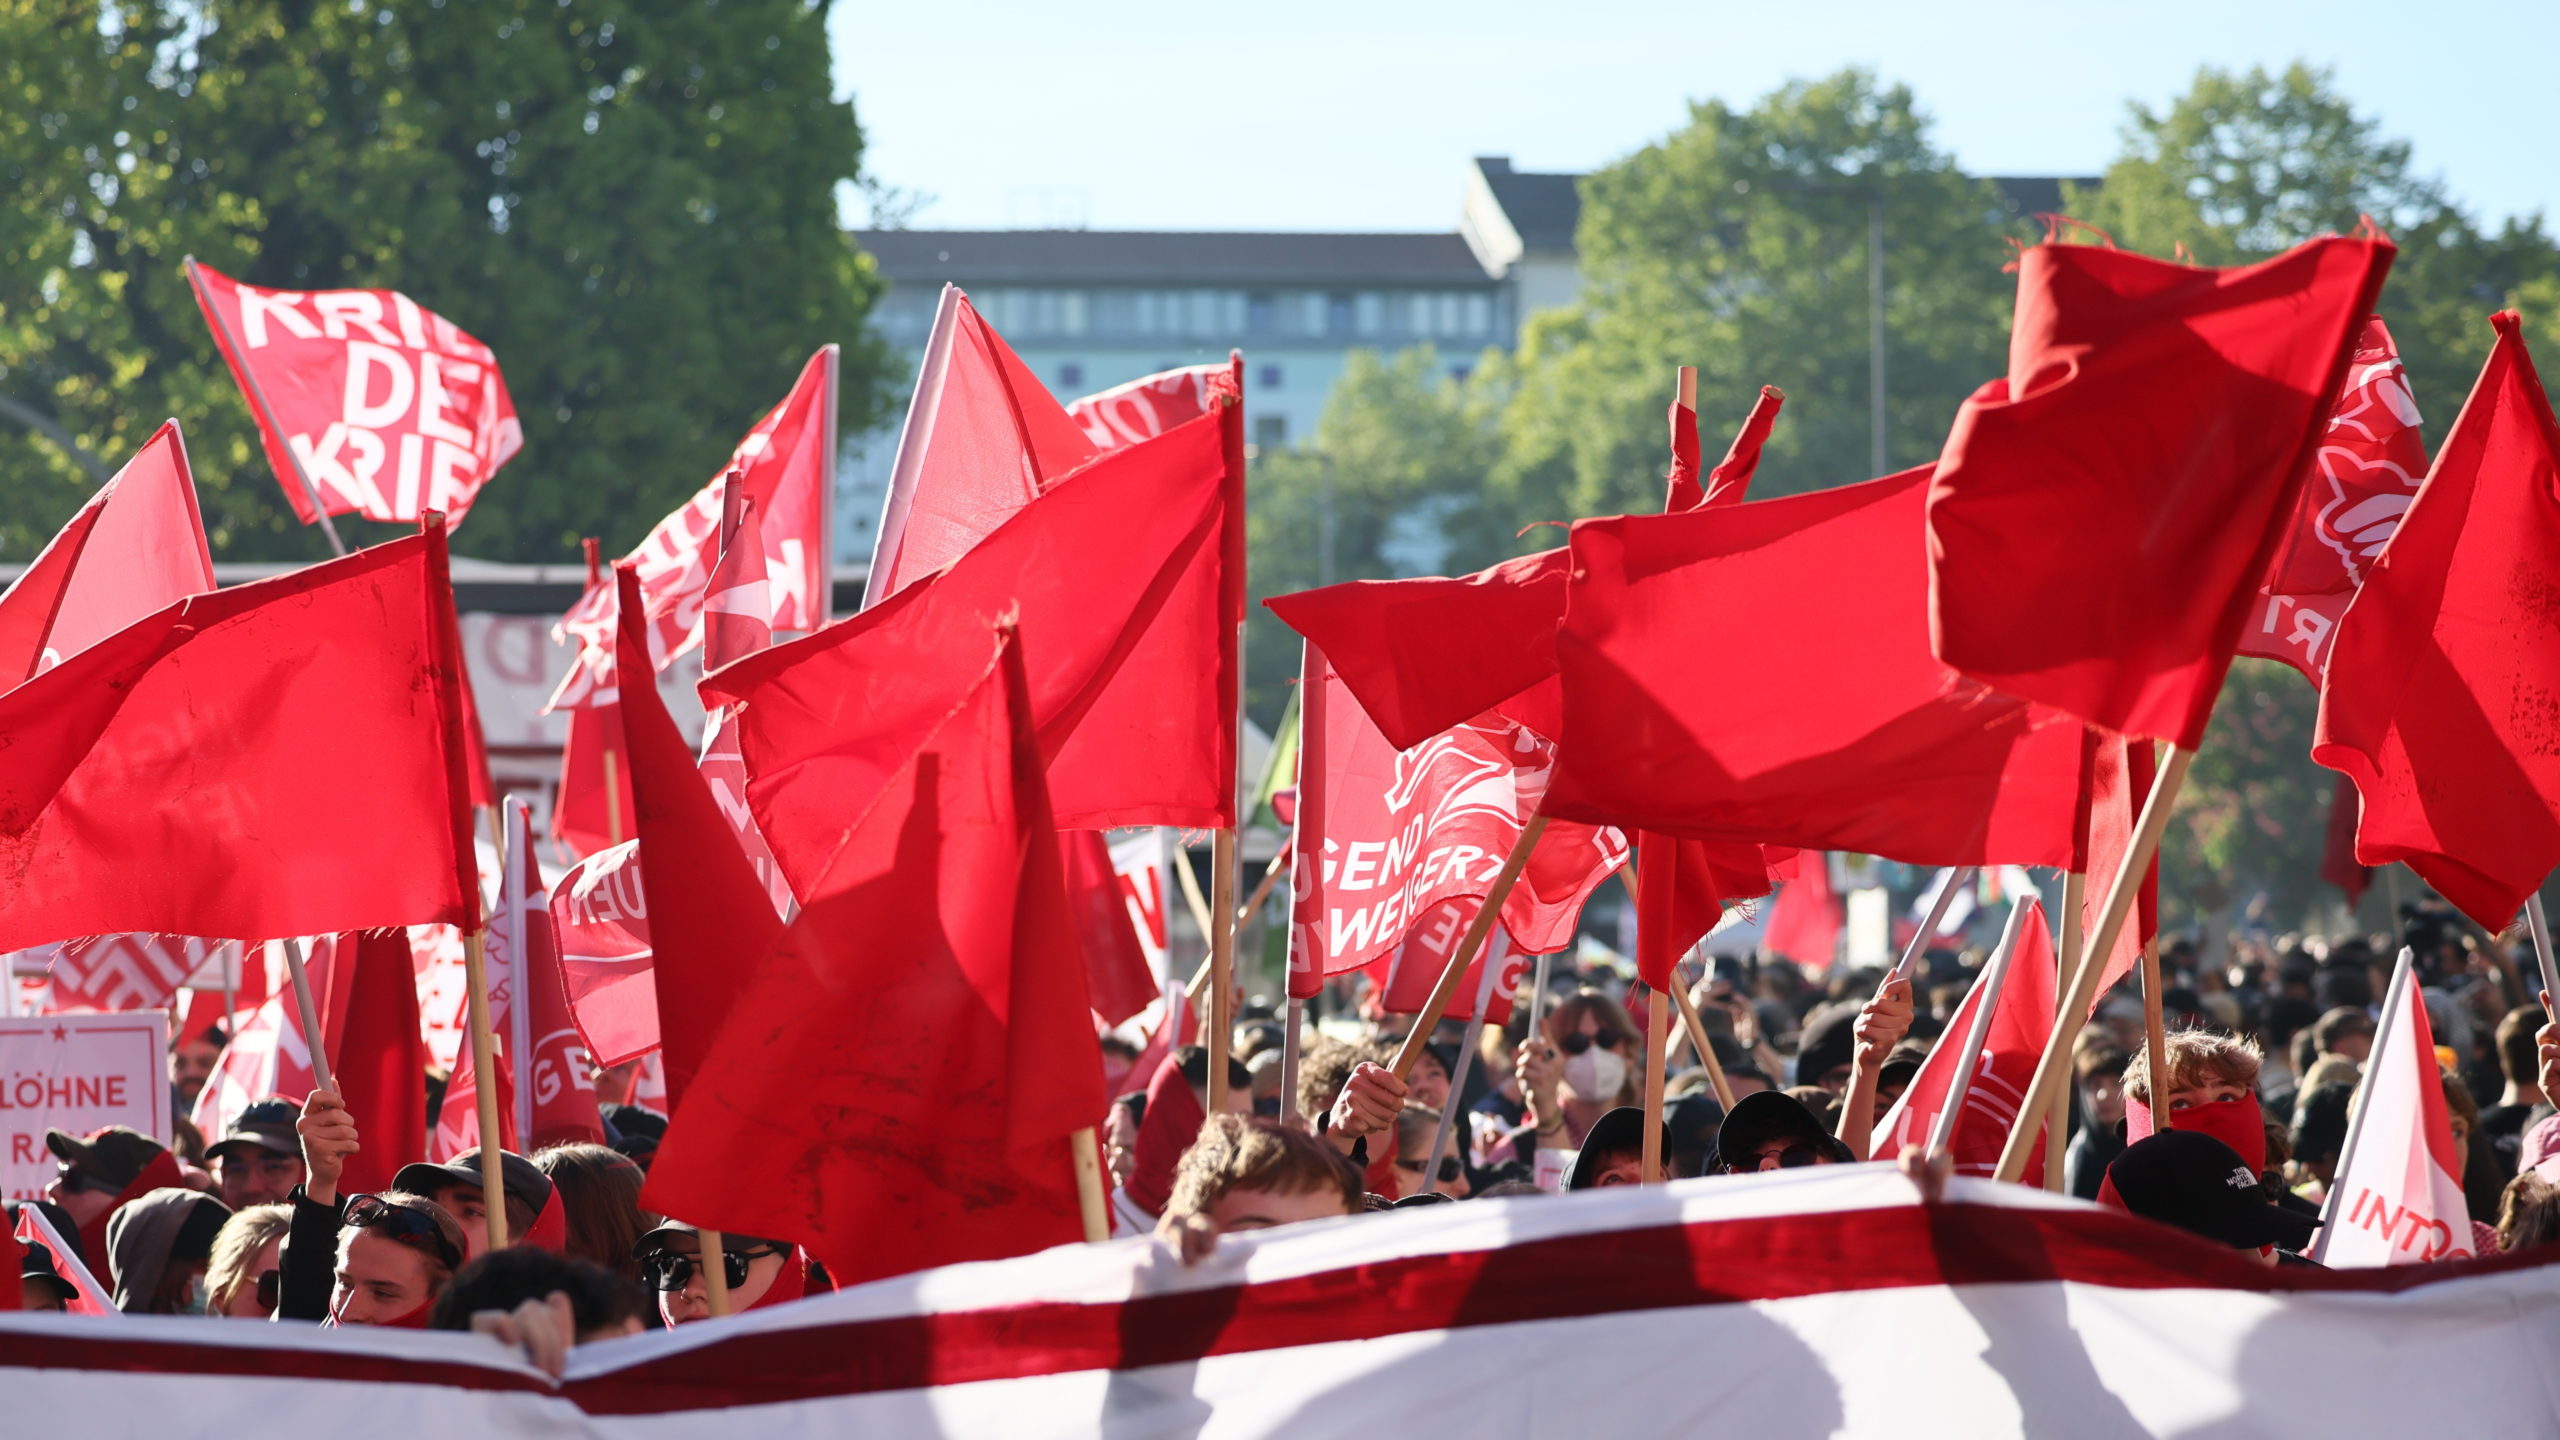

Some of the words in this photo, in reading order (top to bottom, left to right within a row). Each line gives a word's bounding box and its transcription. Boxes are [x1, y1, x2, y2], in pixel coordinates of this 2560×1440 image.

[234, 283, 490, 358] KRIE
[288, 421, 500, 522] KRIE
[0, 1072, 128, 1110] LÖHNE
